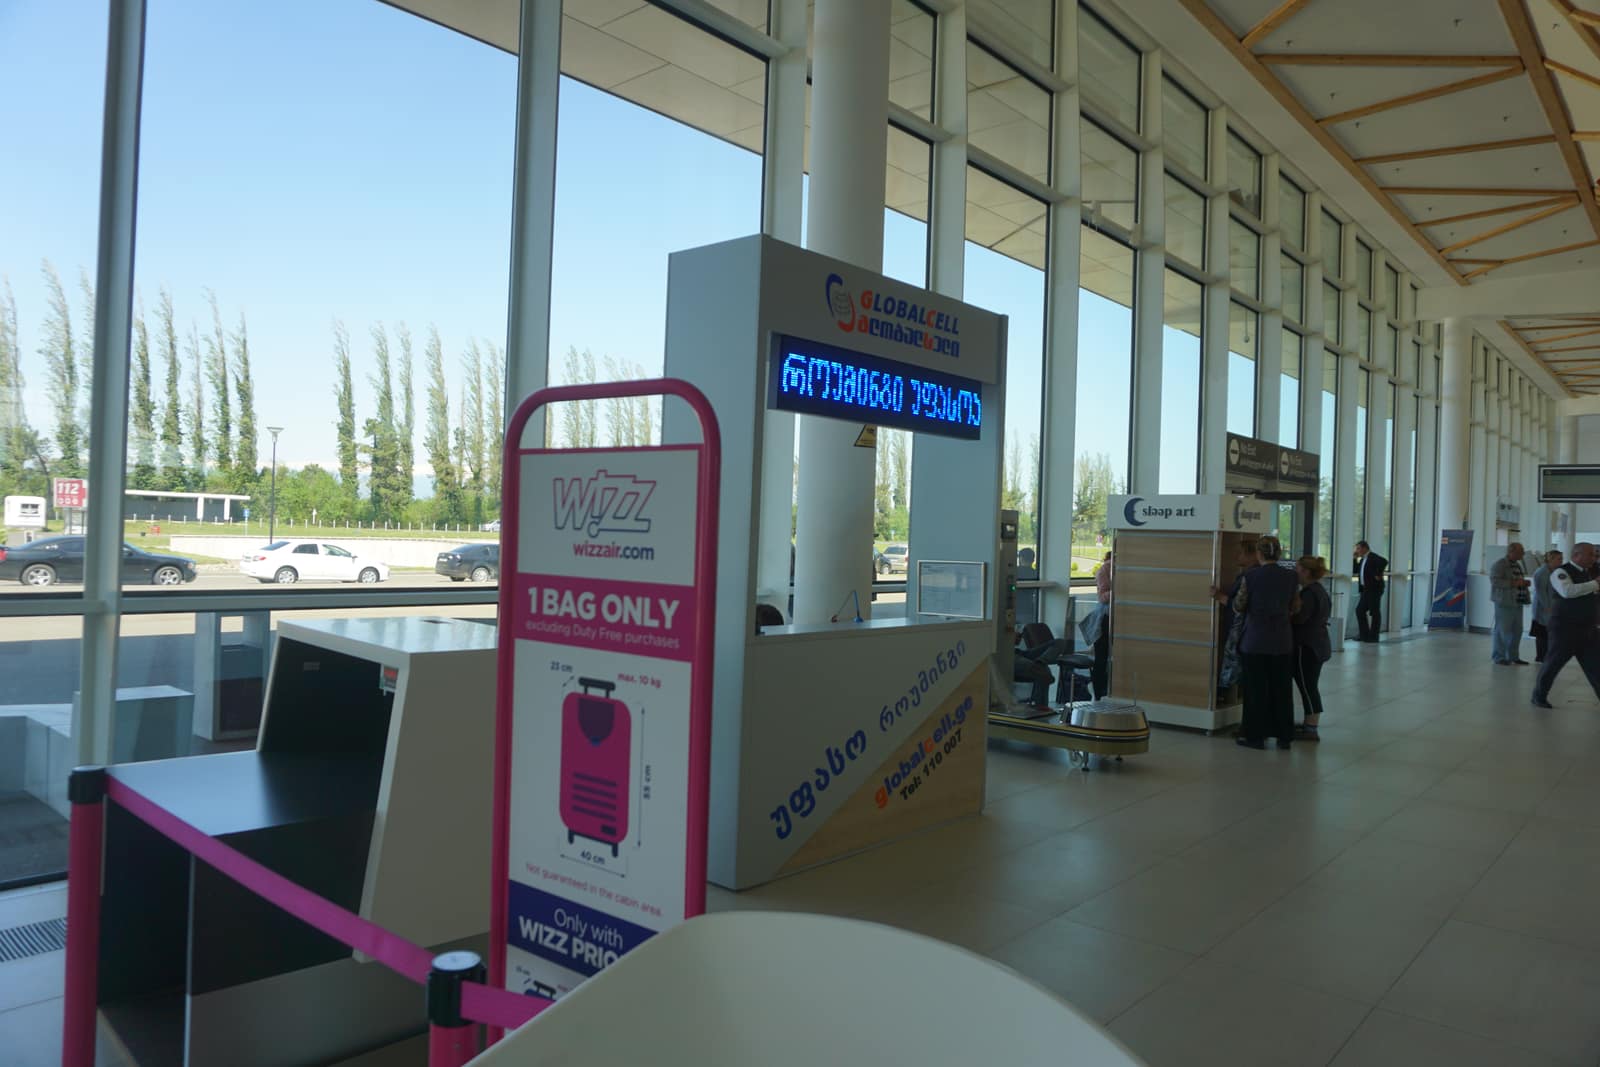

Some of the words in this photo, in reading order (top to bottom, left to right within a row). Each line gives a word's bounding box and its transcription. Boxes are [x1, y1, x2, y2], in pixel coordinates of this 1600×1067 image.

[860, 289, 960, 335] GLOBALCELL
[57, 482, 80, 495] 112
[1175, 505, 1196, 517] art
[573, 541, 655, 561] wizzair.com
[528, 587, 537, 614] 1
[542, 588, 596, 620] BAG
[601, 594, 680, 629] ONLY
[526, 620, 571, 637] excluding
[573, 623, 597, 640] Duty
[599, 627, 623, 641] Free
[625, 631, 680, 649] purchases
[651, 677, 662, 689] kg
[875, 696, 973, 810] globalcell.ge
[900, 776, 922, 801] Tel:
[922, 752, 943, 777] 110
[943, 728, 963, 753] 007
[542, 868, 588, 892] guaranteed
[598, 886, 613, 900] the
[518, 914, 569, 956] WIZZ
[553, 907, 588, 938] Only
[591, 924, 624, 951] with
